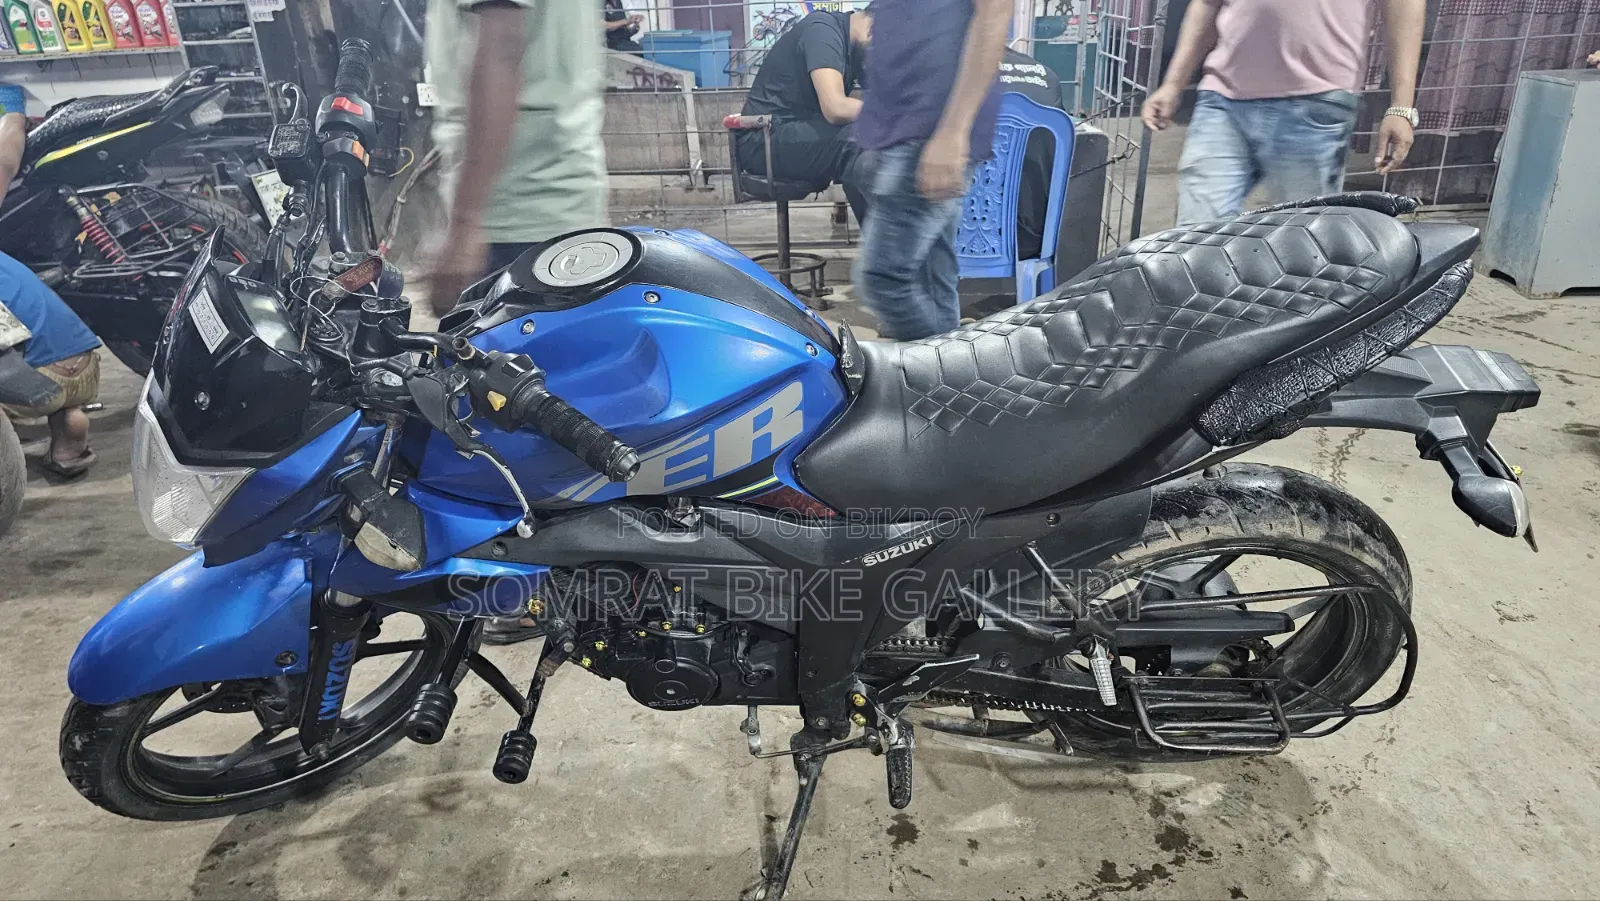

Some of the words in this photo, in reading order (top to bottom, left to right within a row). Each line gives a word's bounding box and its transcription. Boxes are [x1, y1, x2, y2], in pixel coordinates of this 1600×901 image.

[862, 535, 934, 567] SUZUKI
[317, 639, 357, 721] SUZUKI
[647, 697, 700, 707] SUZUKI
